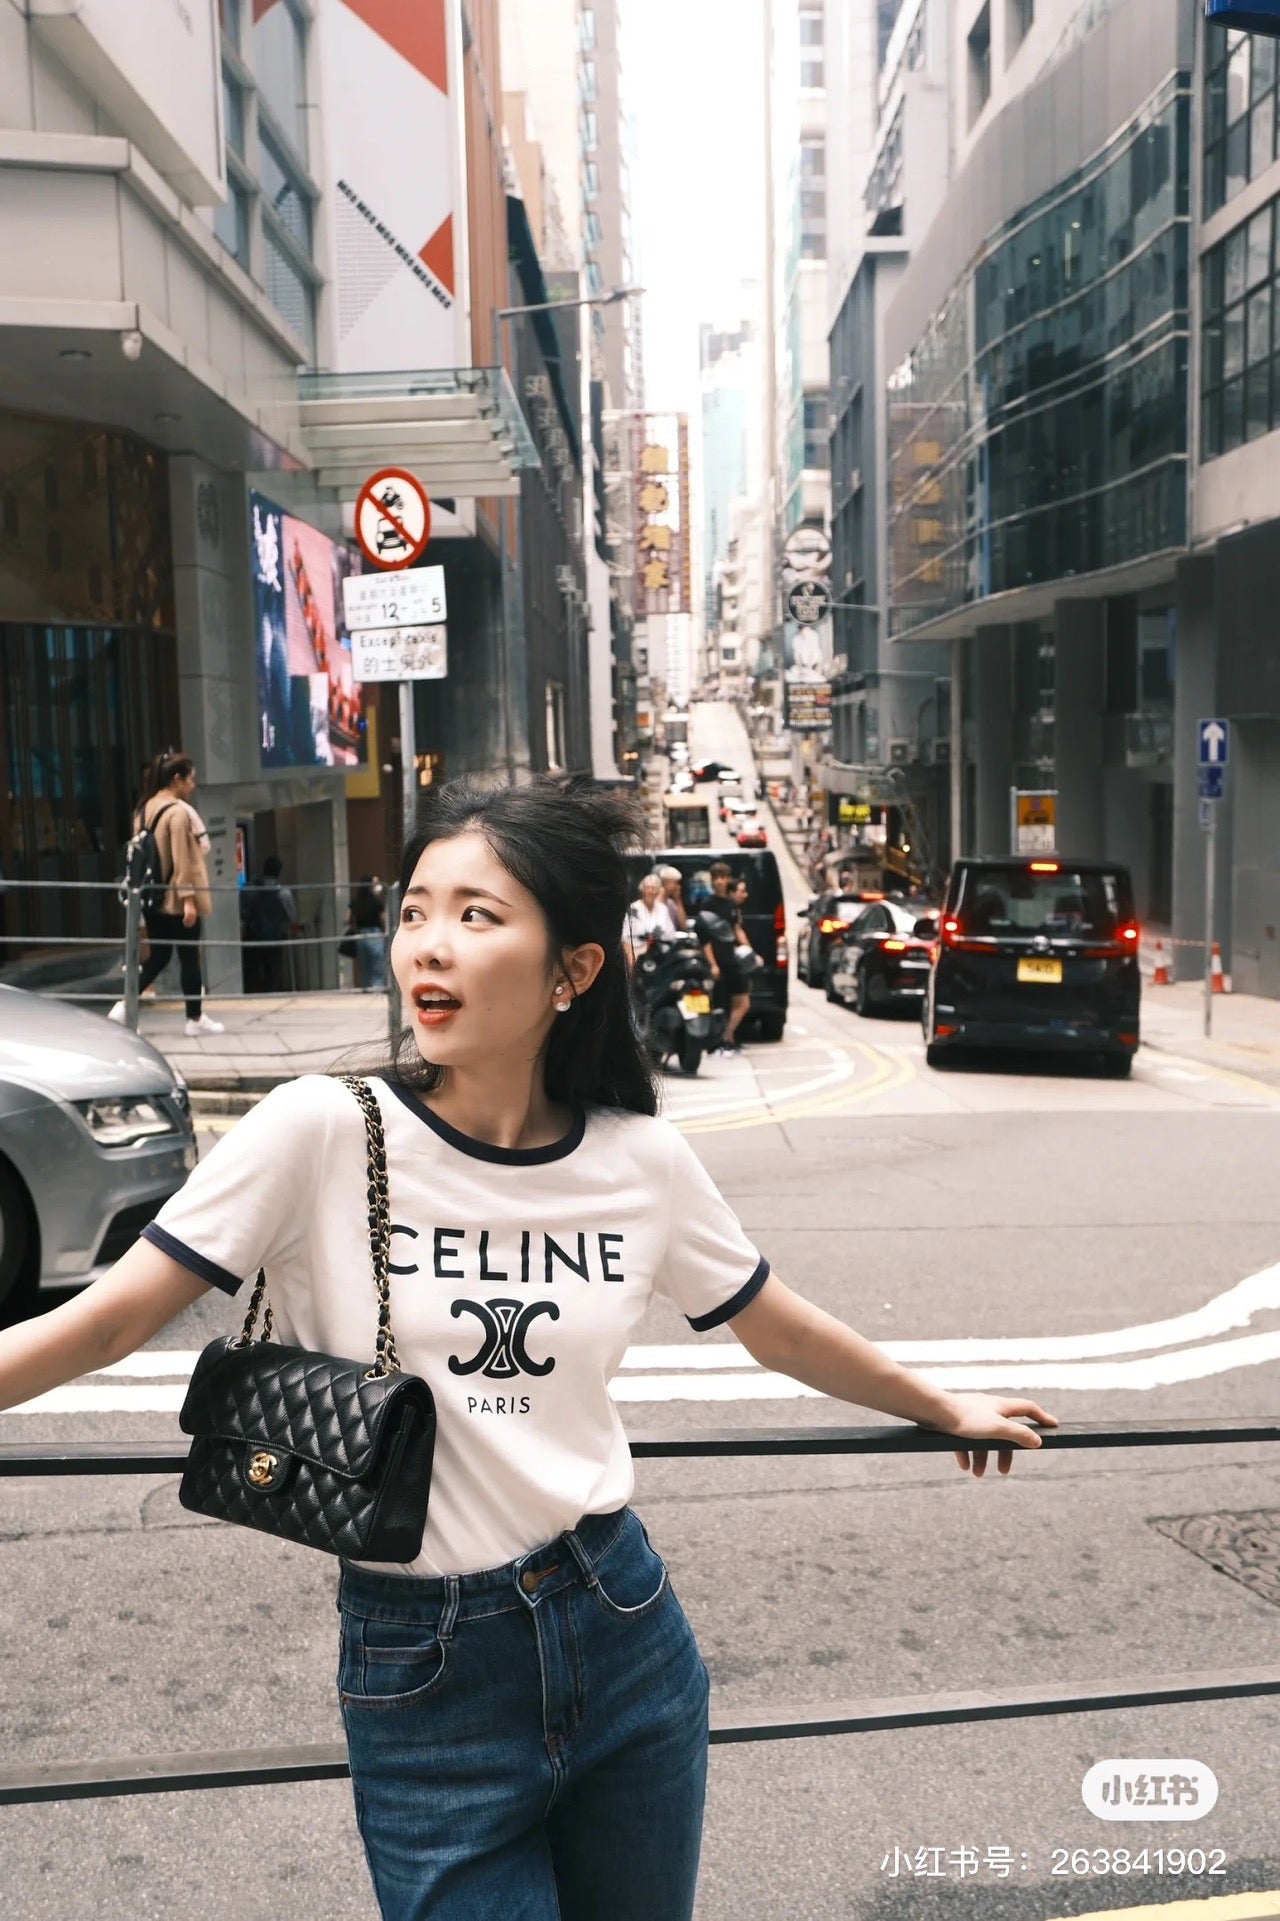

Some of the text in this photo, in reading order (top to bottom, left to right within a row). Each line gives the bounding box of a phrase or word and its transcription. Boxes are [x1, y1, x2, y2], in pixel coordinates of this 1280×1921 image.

[382, 602, 399, 620] 12
[432, 598, 441, 613] 5
[388, 1224, 625, 1283] CELINE
[467, 1396, 531, 1415] PARIS
